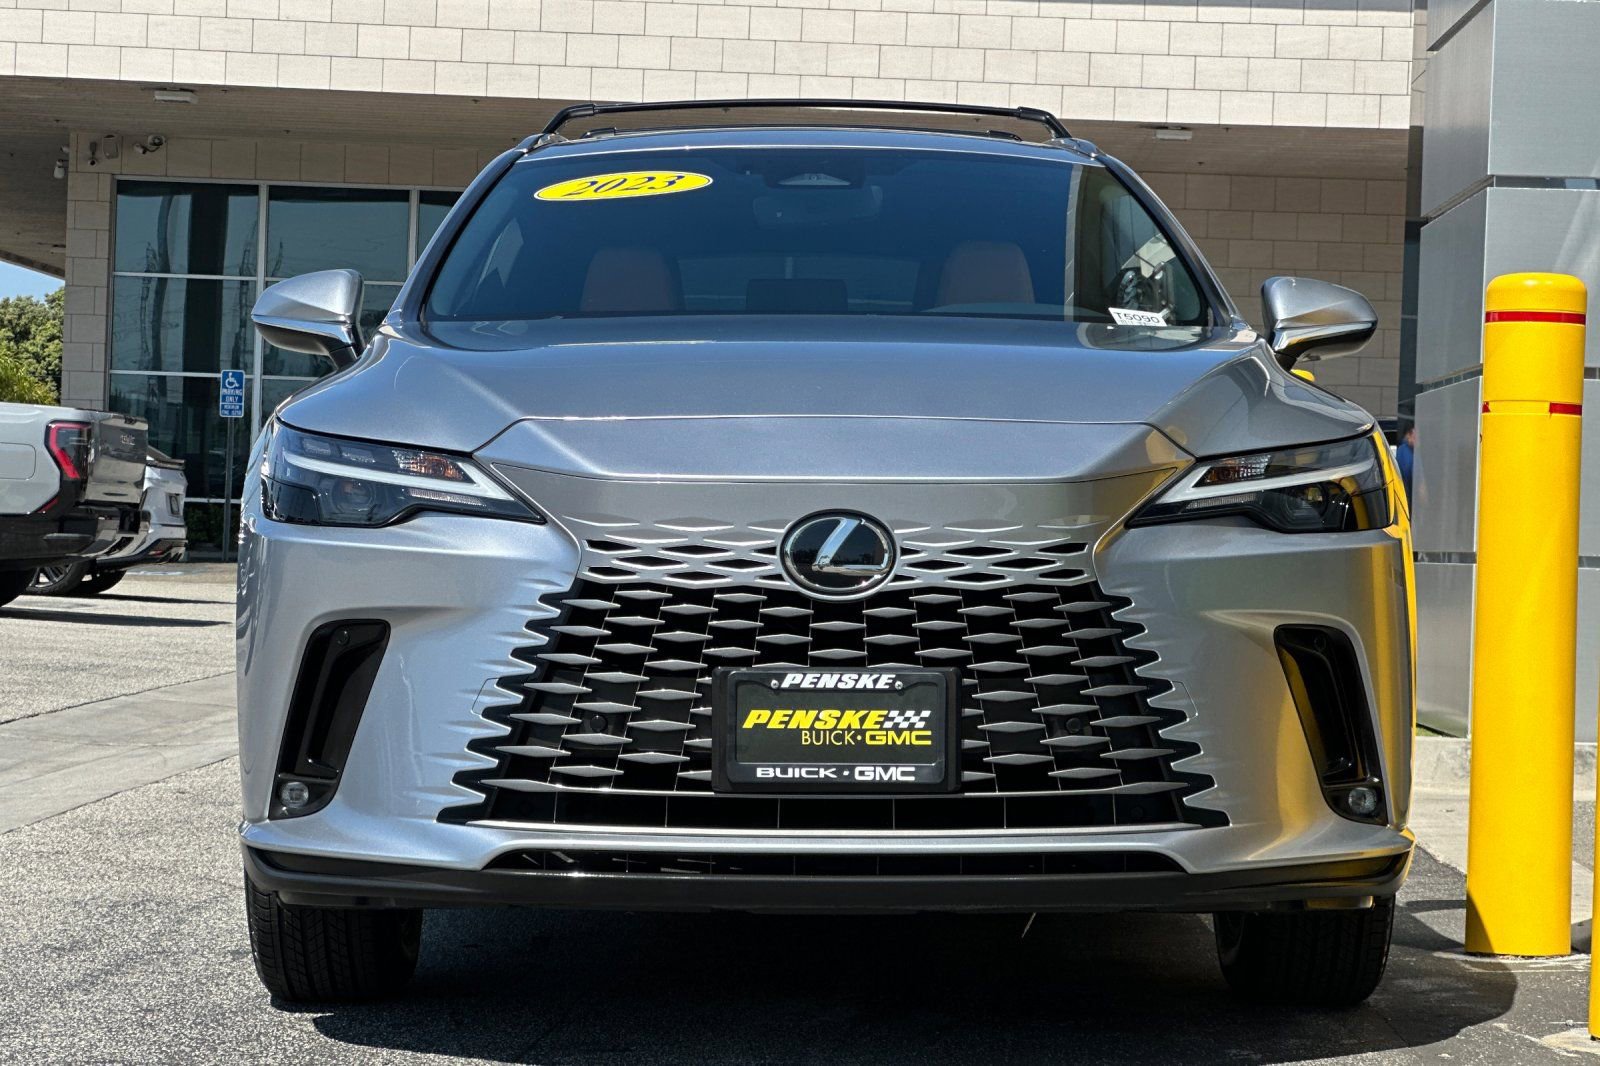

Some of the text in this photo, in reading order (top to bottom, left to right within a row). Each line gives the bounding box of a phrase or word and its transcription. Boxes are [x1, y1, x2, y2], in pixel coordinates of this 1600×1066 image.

[561, 175, 685, 198] 2023
[1112, 311, 1160, 324] T5090
[225, 395, 239, 403] ONLY
[780, 673, 896, 689] PENSKE
[742, 709, 888, 729] PENSKE
[756, 766, 916, 781] BUICK GMC
